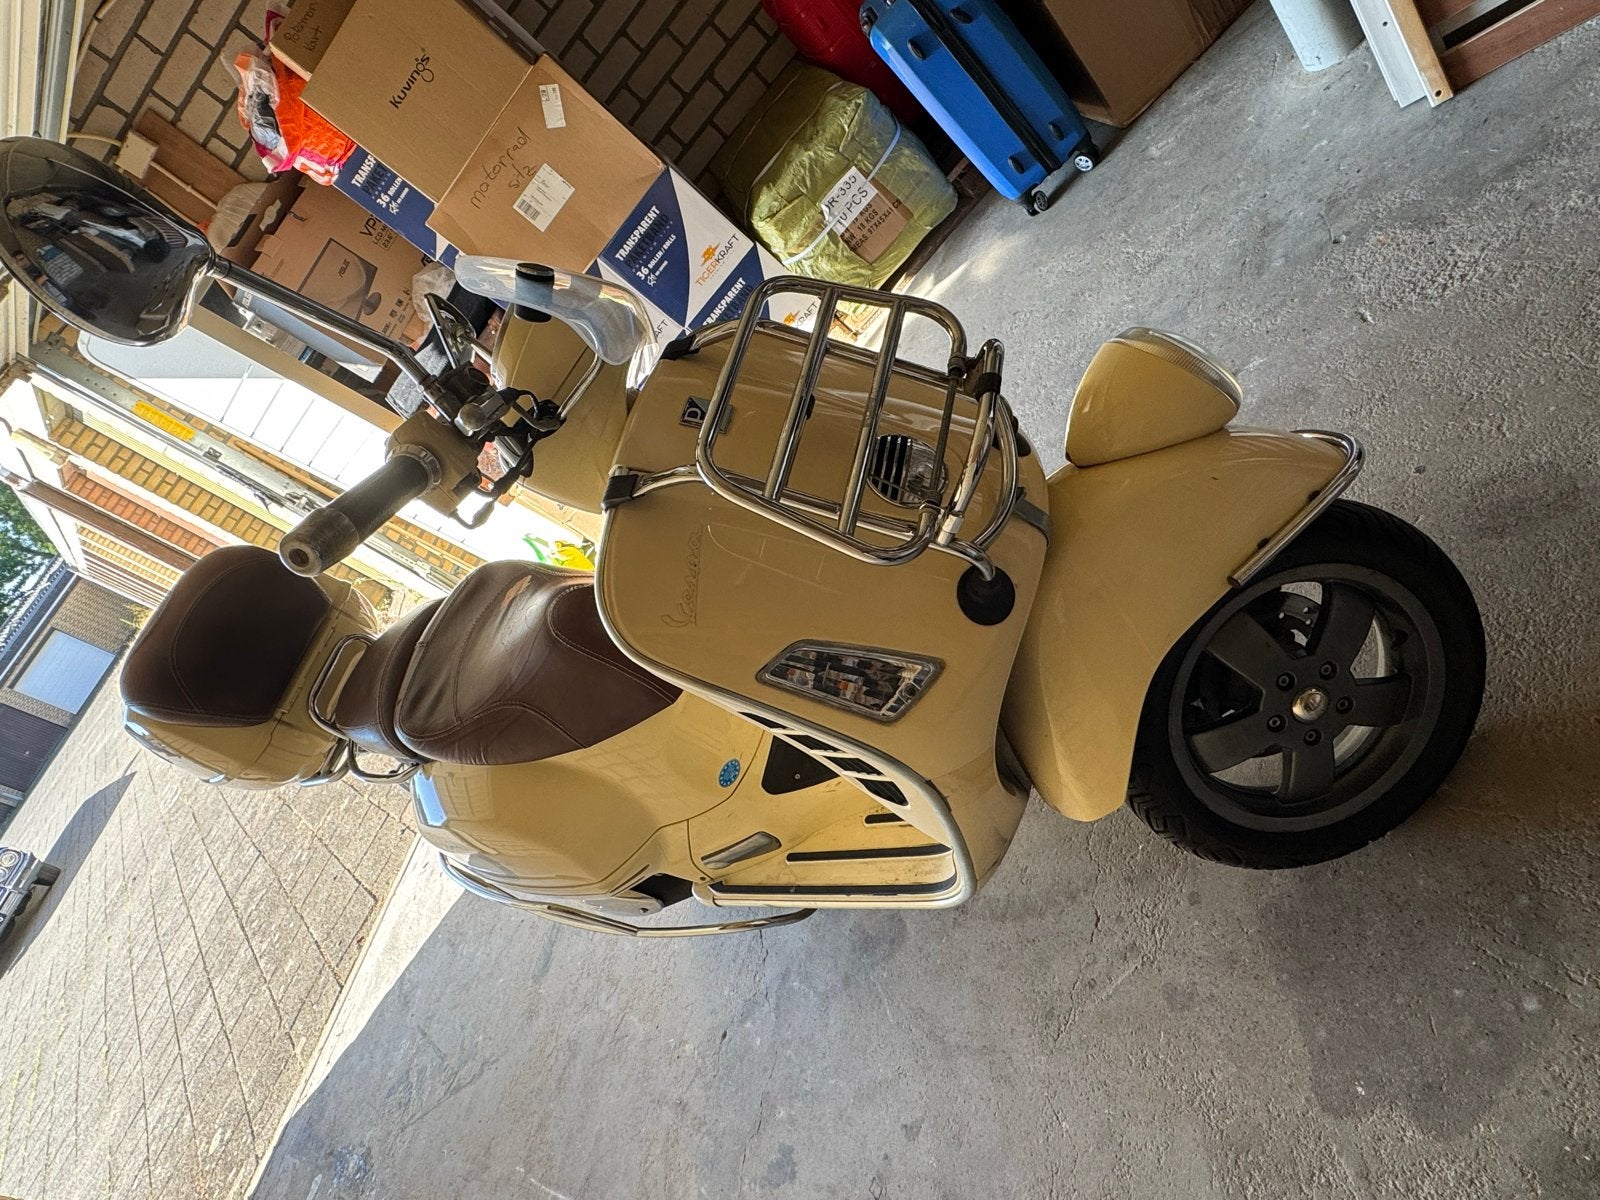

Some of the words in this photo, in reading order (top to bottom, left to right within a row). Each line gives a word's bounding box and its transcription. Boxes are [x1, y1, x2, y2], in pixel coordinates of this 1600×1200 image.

[389, 53, 434, 109] Kuvings
[376, 193, 390, 208] 36
[845, 186, 869, 213] PCS
[864, 209, 878, 224] KGS
[615, 205, 660, 261] TRANSPARENT
[636, 265, 650, 280] 36
[695, 233, 739, 287] TIGERKRAFT
